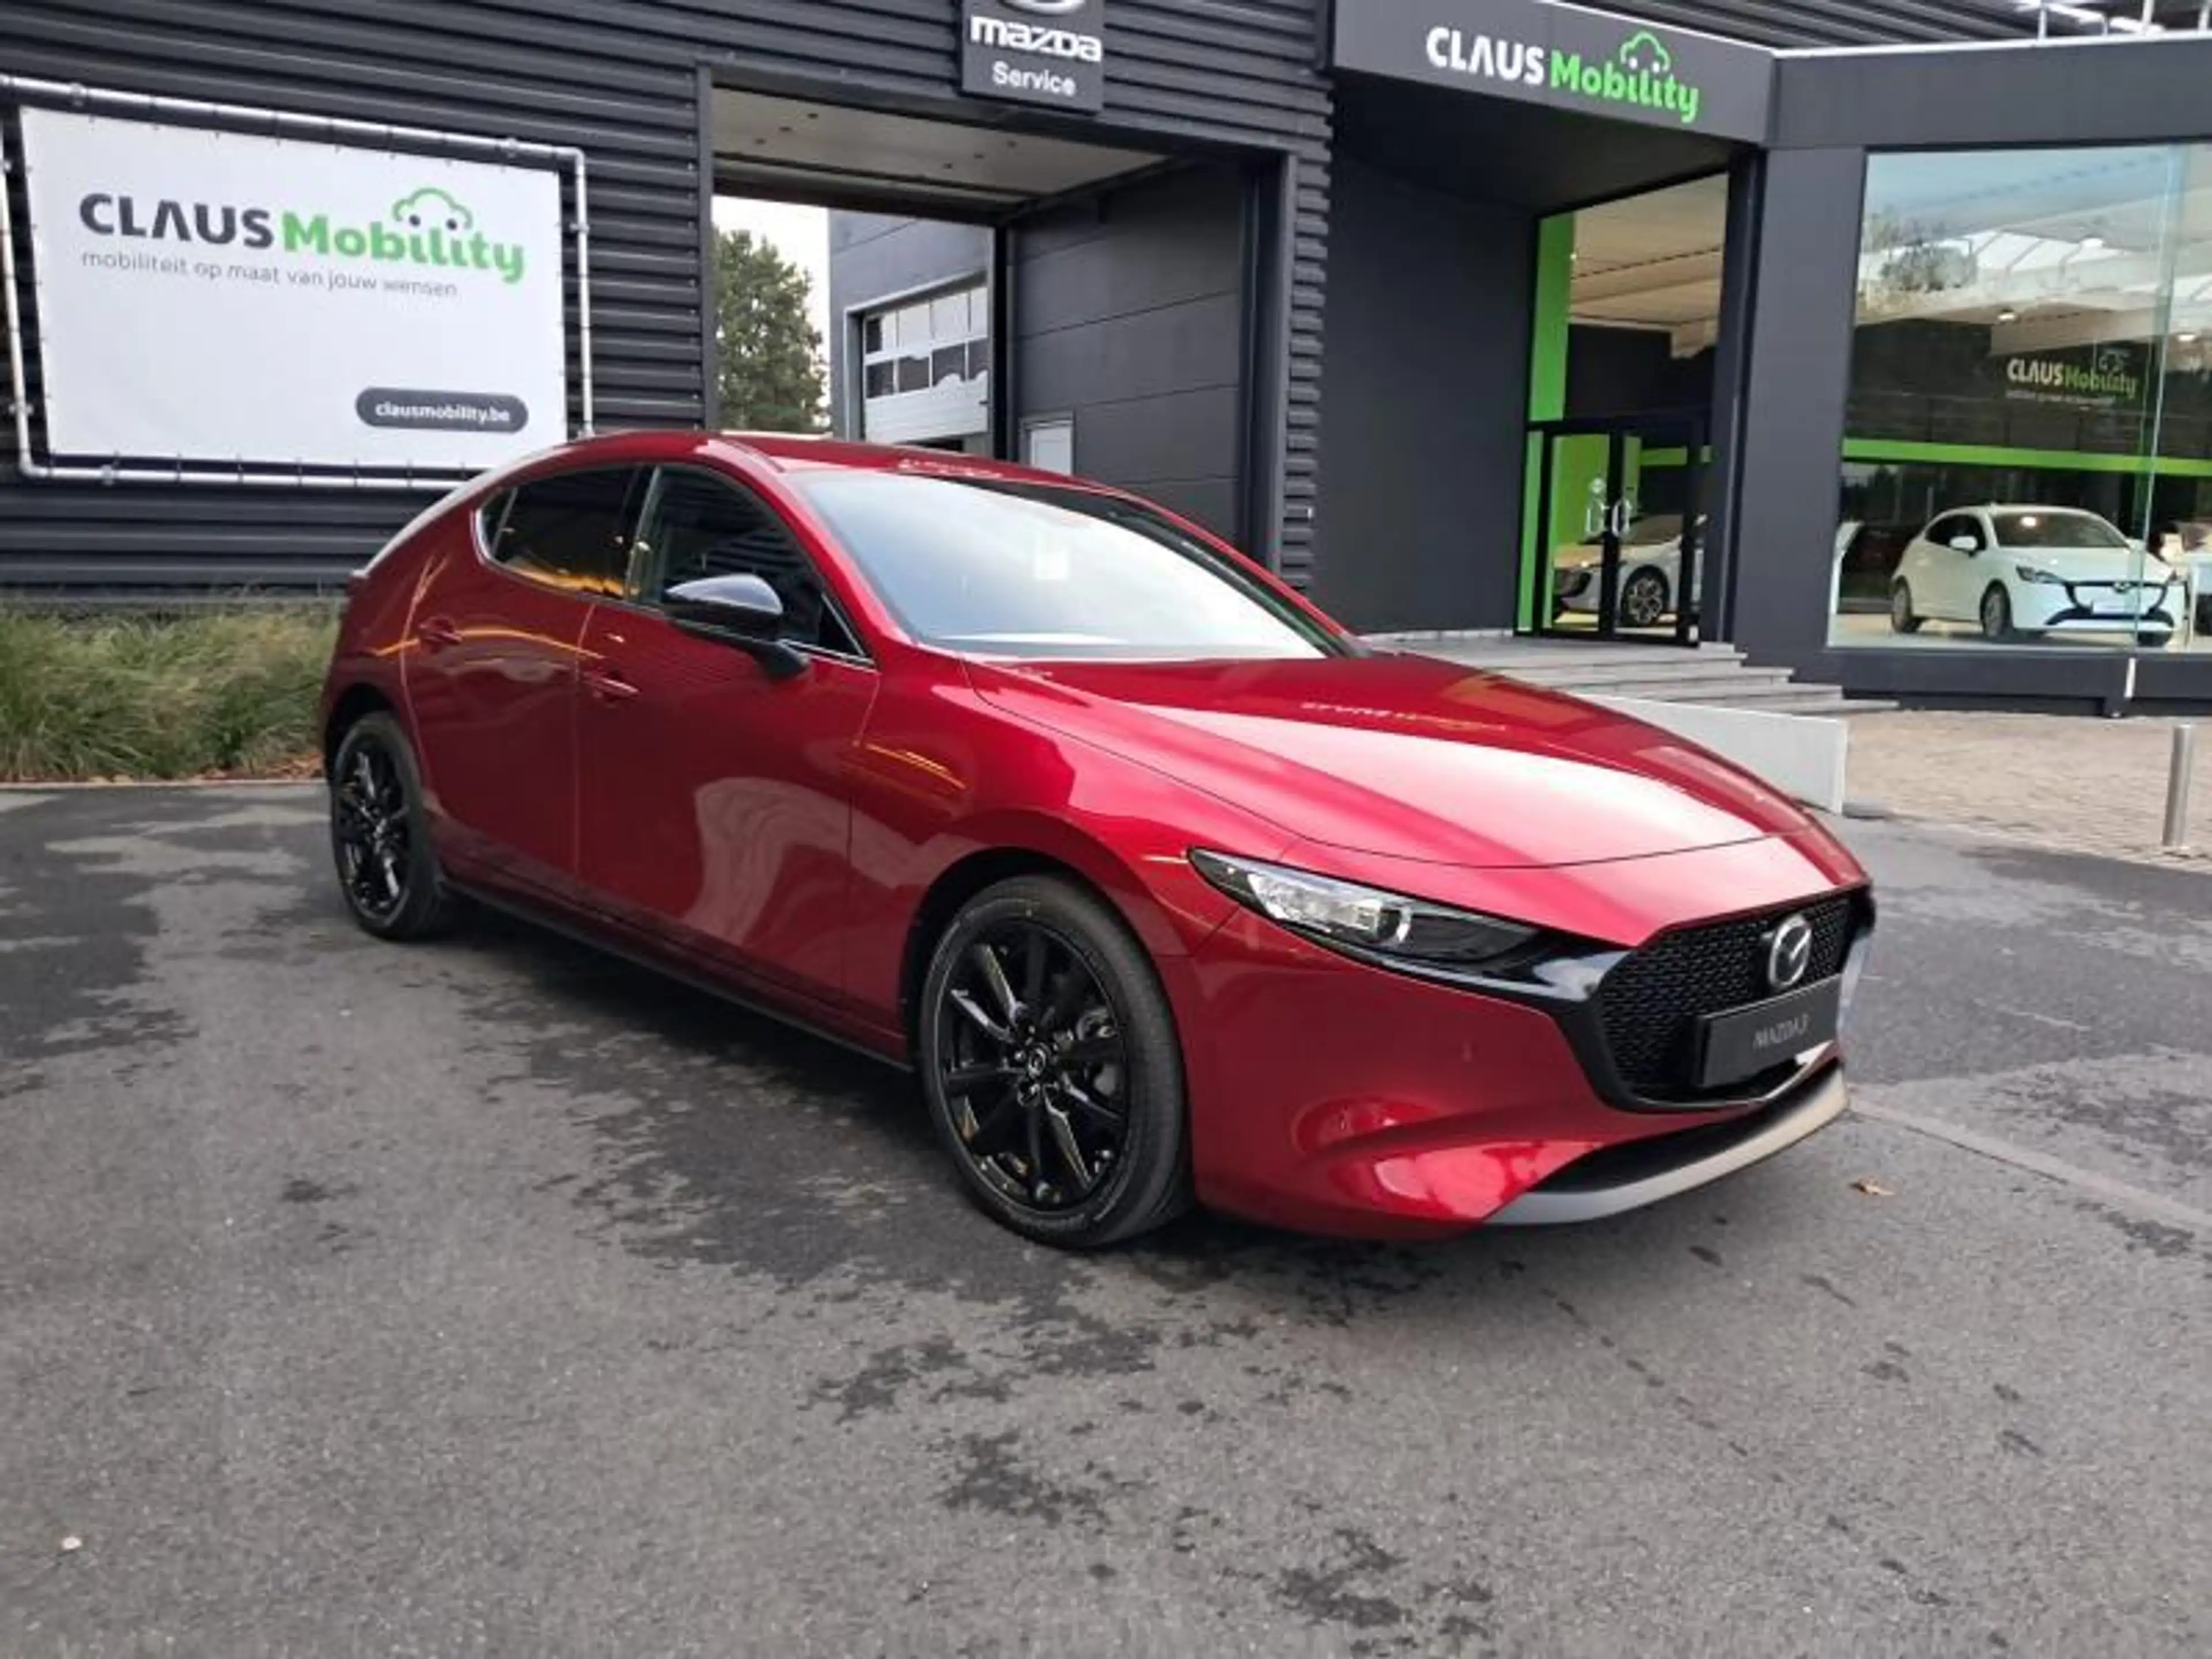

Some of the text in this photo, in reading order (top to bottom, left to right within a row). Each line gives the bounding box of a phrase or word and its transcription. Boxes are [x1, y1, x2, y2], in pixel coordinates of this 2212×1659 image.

[992, 60, 1076, 97] Service
[1426, 26, 1699, 123] CLAUS Mobility
[79, 192, 524, 284] CLAUS Mobility
[81, 251, 188, 275] mobiliteit
[194, 261, 222, 281] op
[226, 263, 280, 284] maat
[287, 269, 323, 285] van
[328, 270, 377, 291] jouw
[2006, 358, 2063, 387] CLAUS
[376, 401, 510, 426] clausmobility.be
